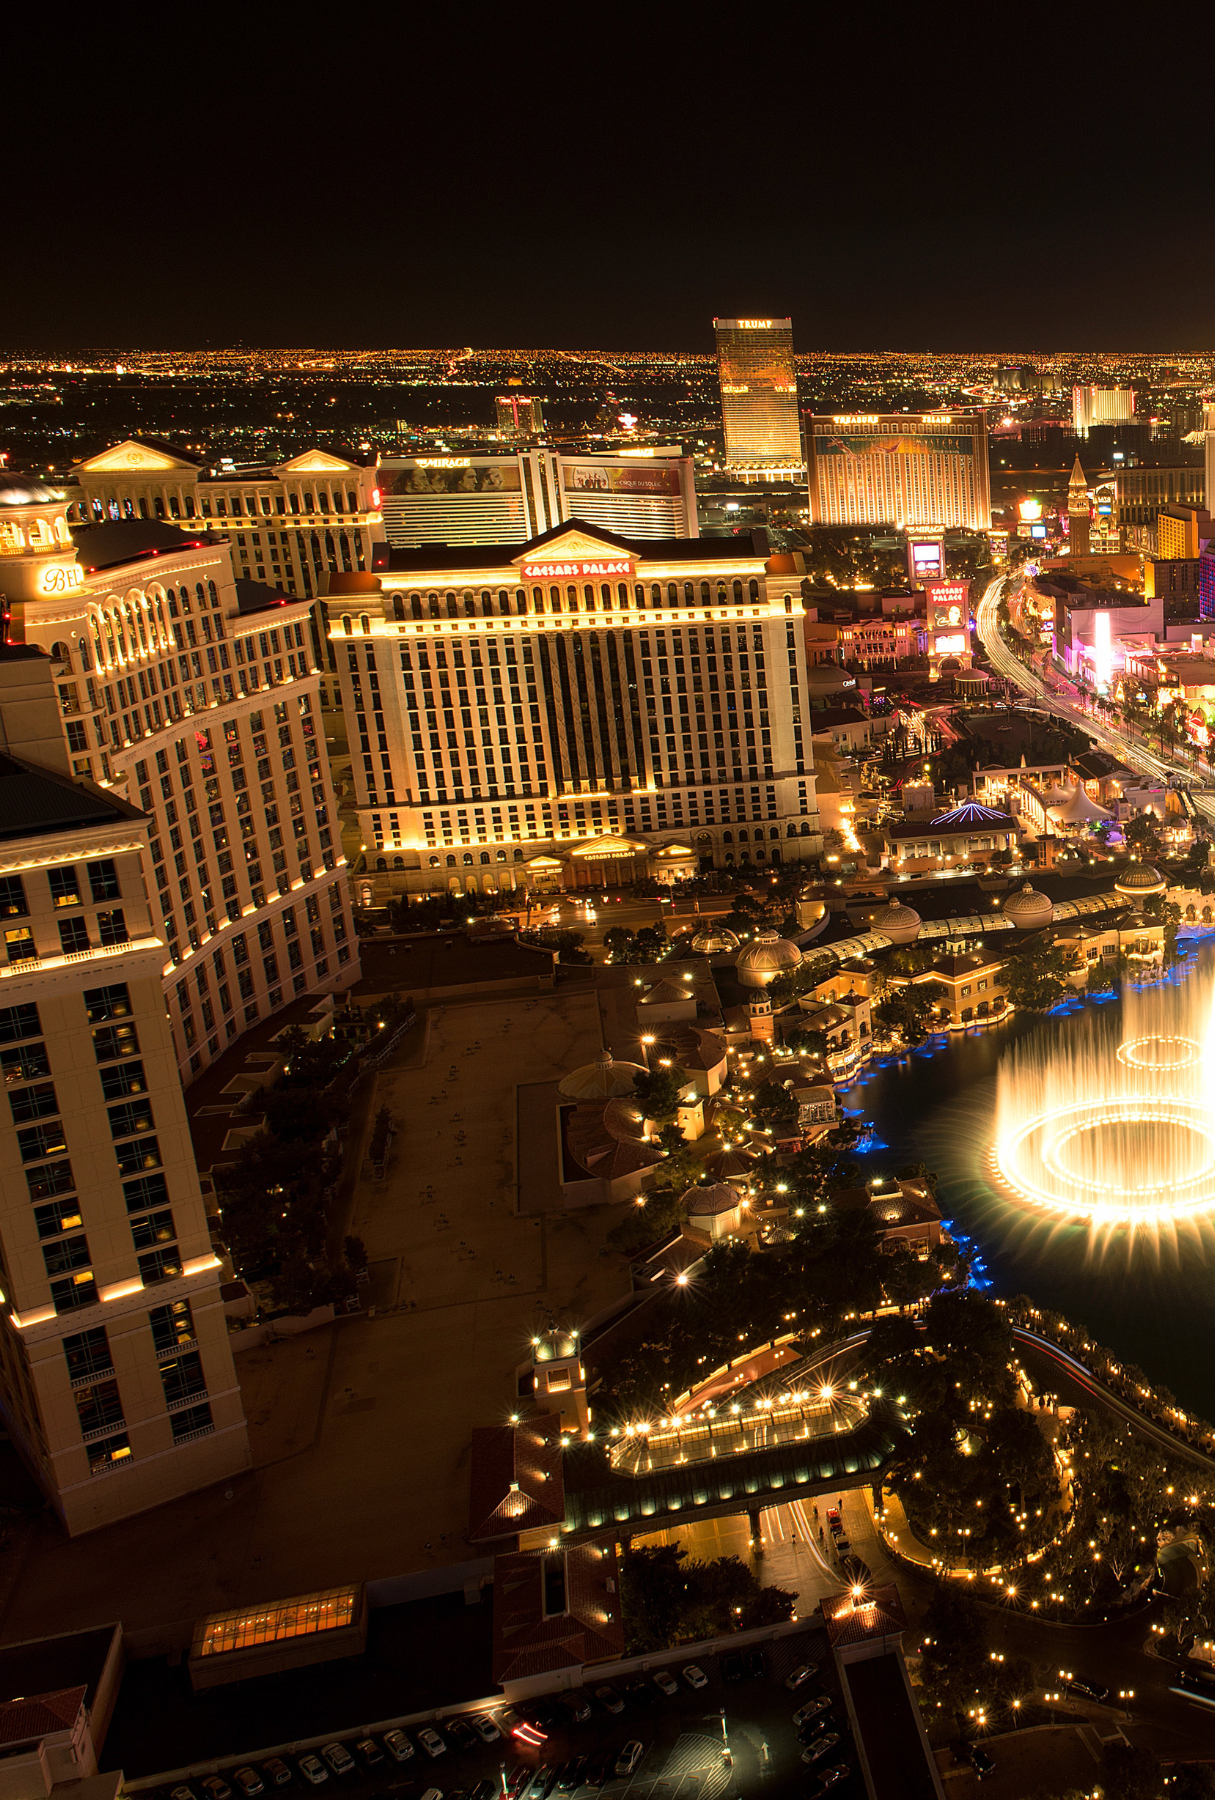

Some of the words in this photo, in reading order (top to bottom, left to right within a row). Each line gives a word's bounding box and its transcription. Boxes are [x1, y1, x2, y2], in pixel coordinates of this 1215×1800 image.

[738, 320, 772, 329] TRUMP
[833, 416, 879, 424] TREASURE
[922, 416, 951, 424] ISLAND
[420, 458, 470, 468] MIRAGE
[910, 525, 945, 534] MIRAGE
[525, 564, 579, 577] CAESARS
[582, 562, 630, 574] PALACE
[931, 587, 963, 595] CAESARS
